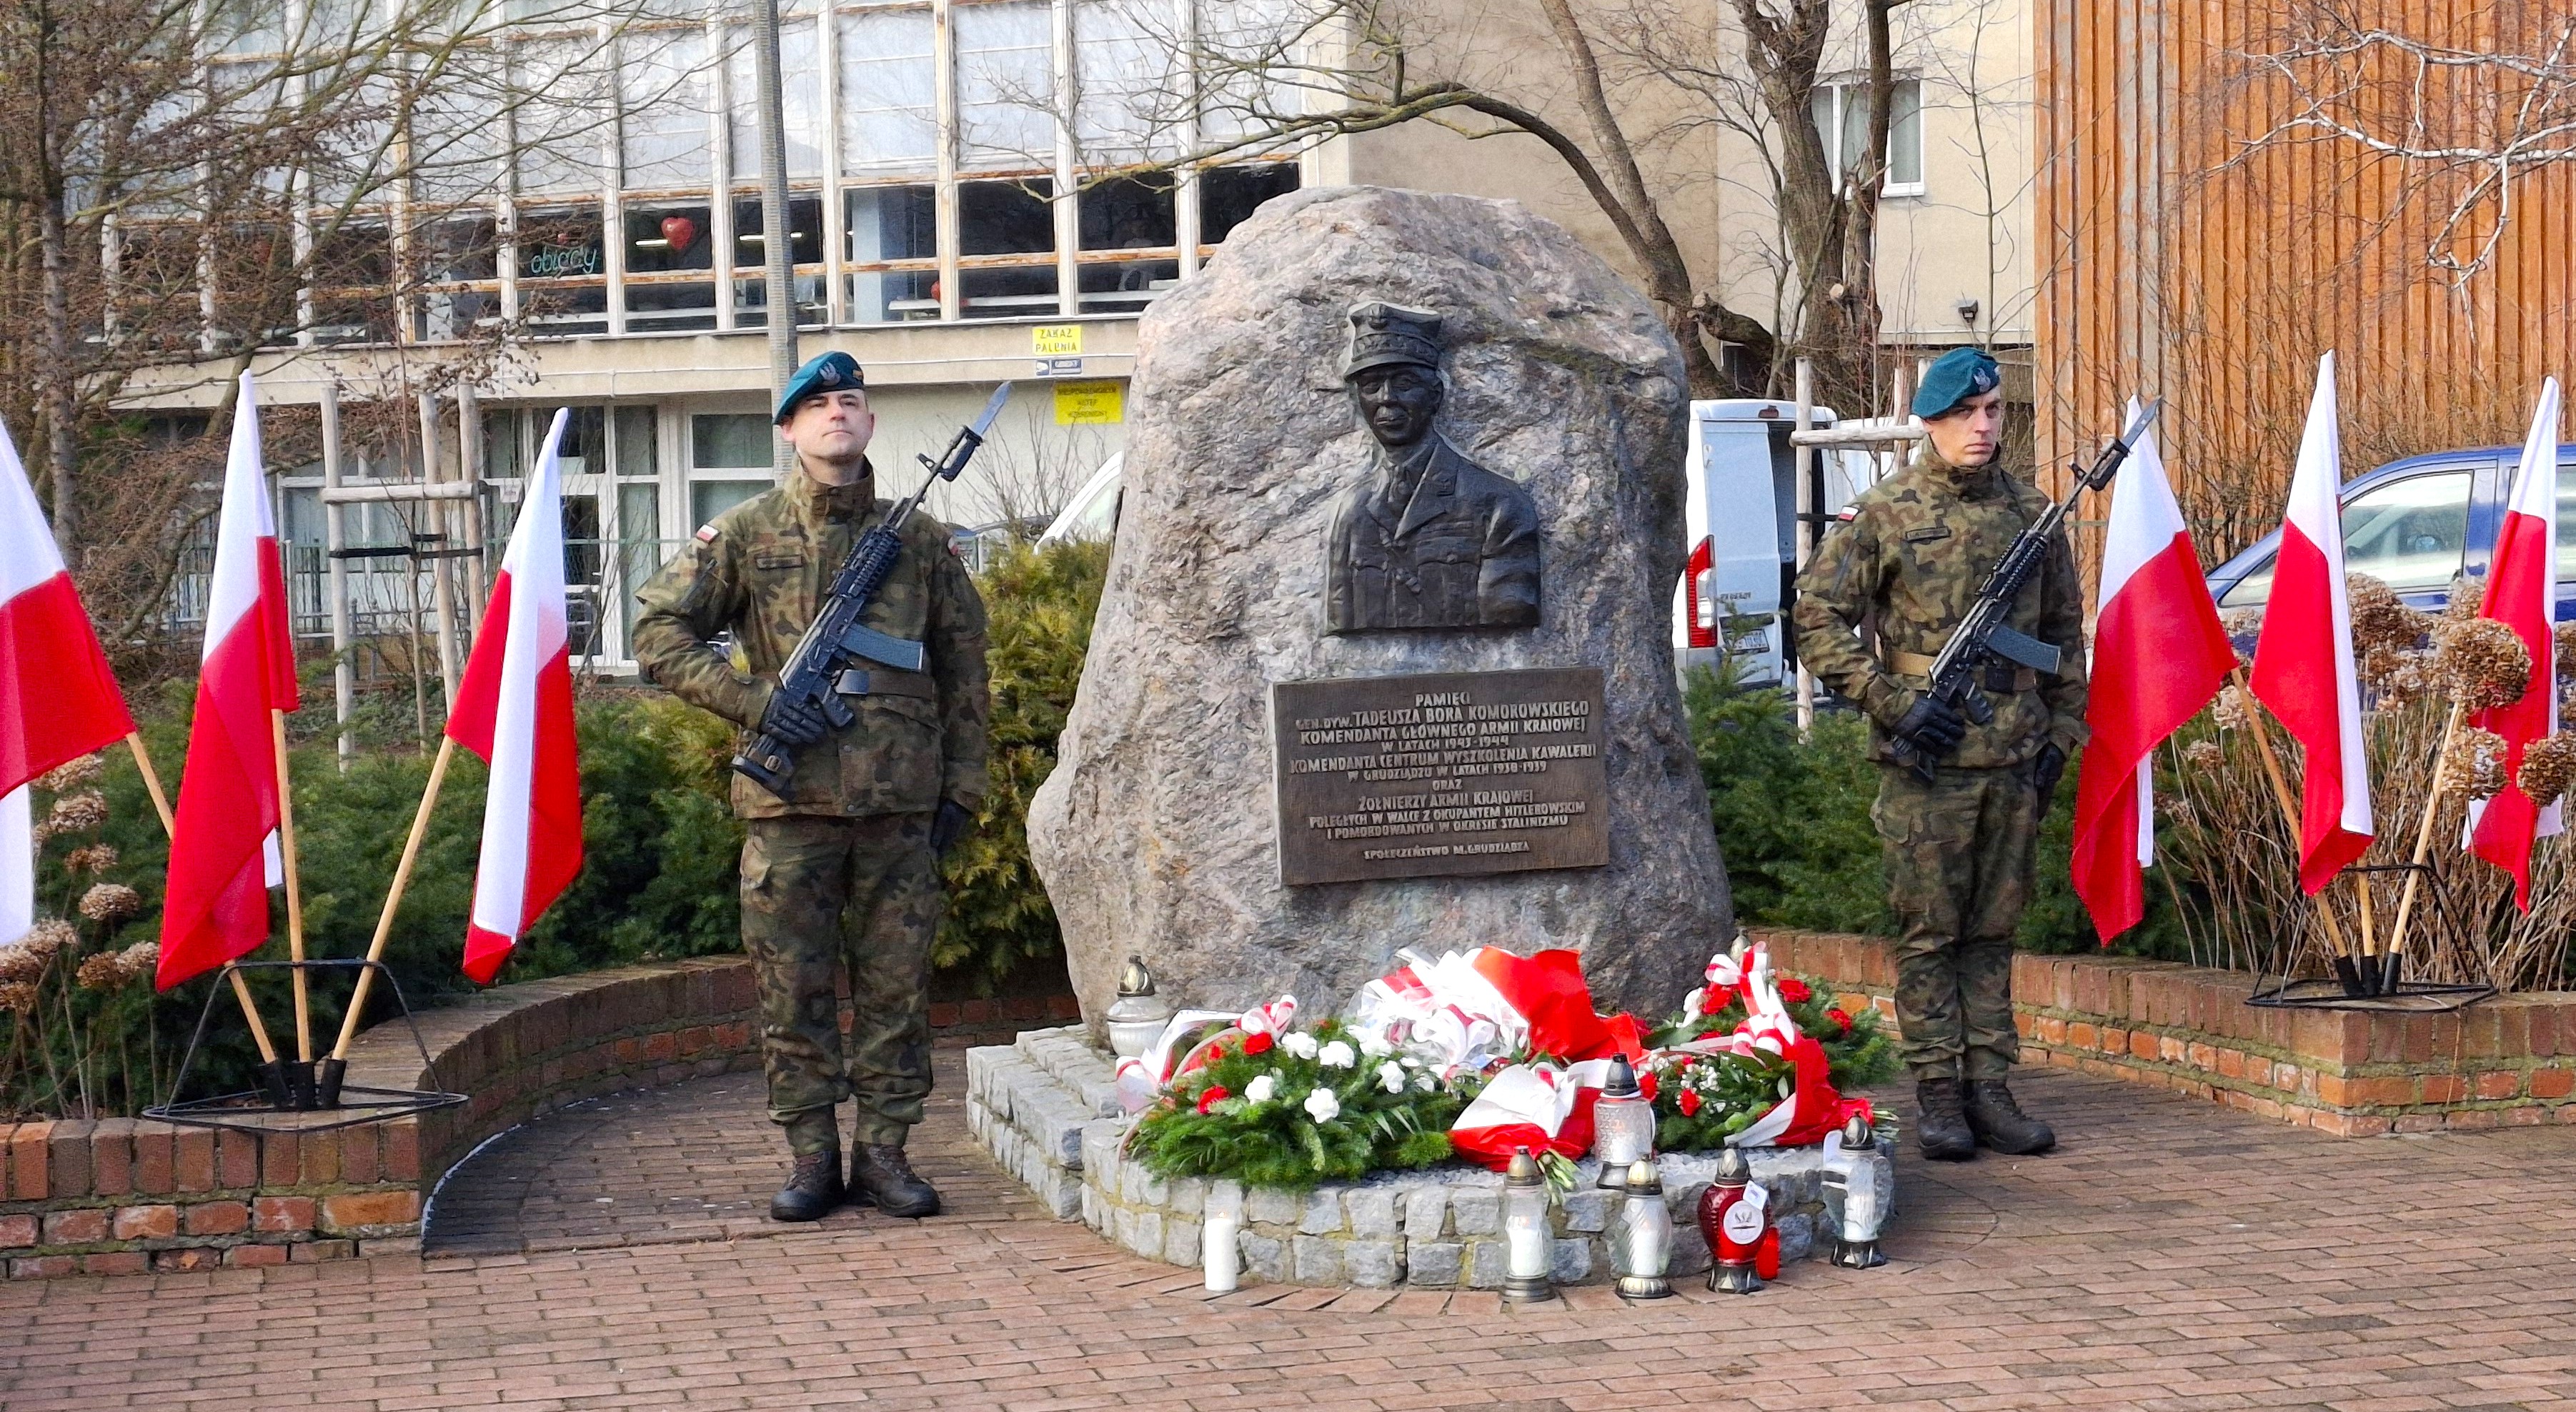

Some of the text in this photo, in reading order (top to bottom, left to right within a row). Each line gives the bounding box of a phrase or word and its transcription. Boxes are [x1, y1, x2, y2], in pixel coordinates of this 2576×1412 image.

[1040, 328, 1073, 338] ZAKAZ
[1035, 342, 1077, 352] PALENIA
[1353, 709, 1421, 727] TADEUSZA
[1426, 705, 1463, 723] BORA
[1468, 701, 1589, 721] KOMOROWSKIEGO
[1301, 727, 1398, 745] KOMENDANTA
[1480, 720, 1518, 735] ARMII
[1381, 741, 1393, 752] W
[1398, 739, 1440, 752] LATACH
[1291, 744, 1596, 774] KOMENDANTA CENTRUM WYSZKOLENIA KAWALERII
[1347, 770, 1358, 782] W
[1363, 767, 1432, 782] GRUDZIĄDZU
[1437, 766, 1448, 777] W
[1453, 763, 1489, 776] LATACH
[1432, 778, 1463, 791] ORAZ
[1358, 794, 1427, 812] ŻOŁNIERZY
[1429, 792, 1468, 808] ARMII
[1309, 801, 1586, 828] POLEGŁYCH W WALCE Z OKUPANTEM HITLEROWSKIM
[1327, 815, 1568, 840] I POMORDOWANYCH W OKRESIE STALINIZMU
[1363, 845, 1449, 860] SPOŁECZEŃSTWO
